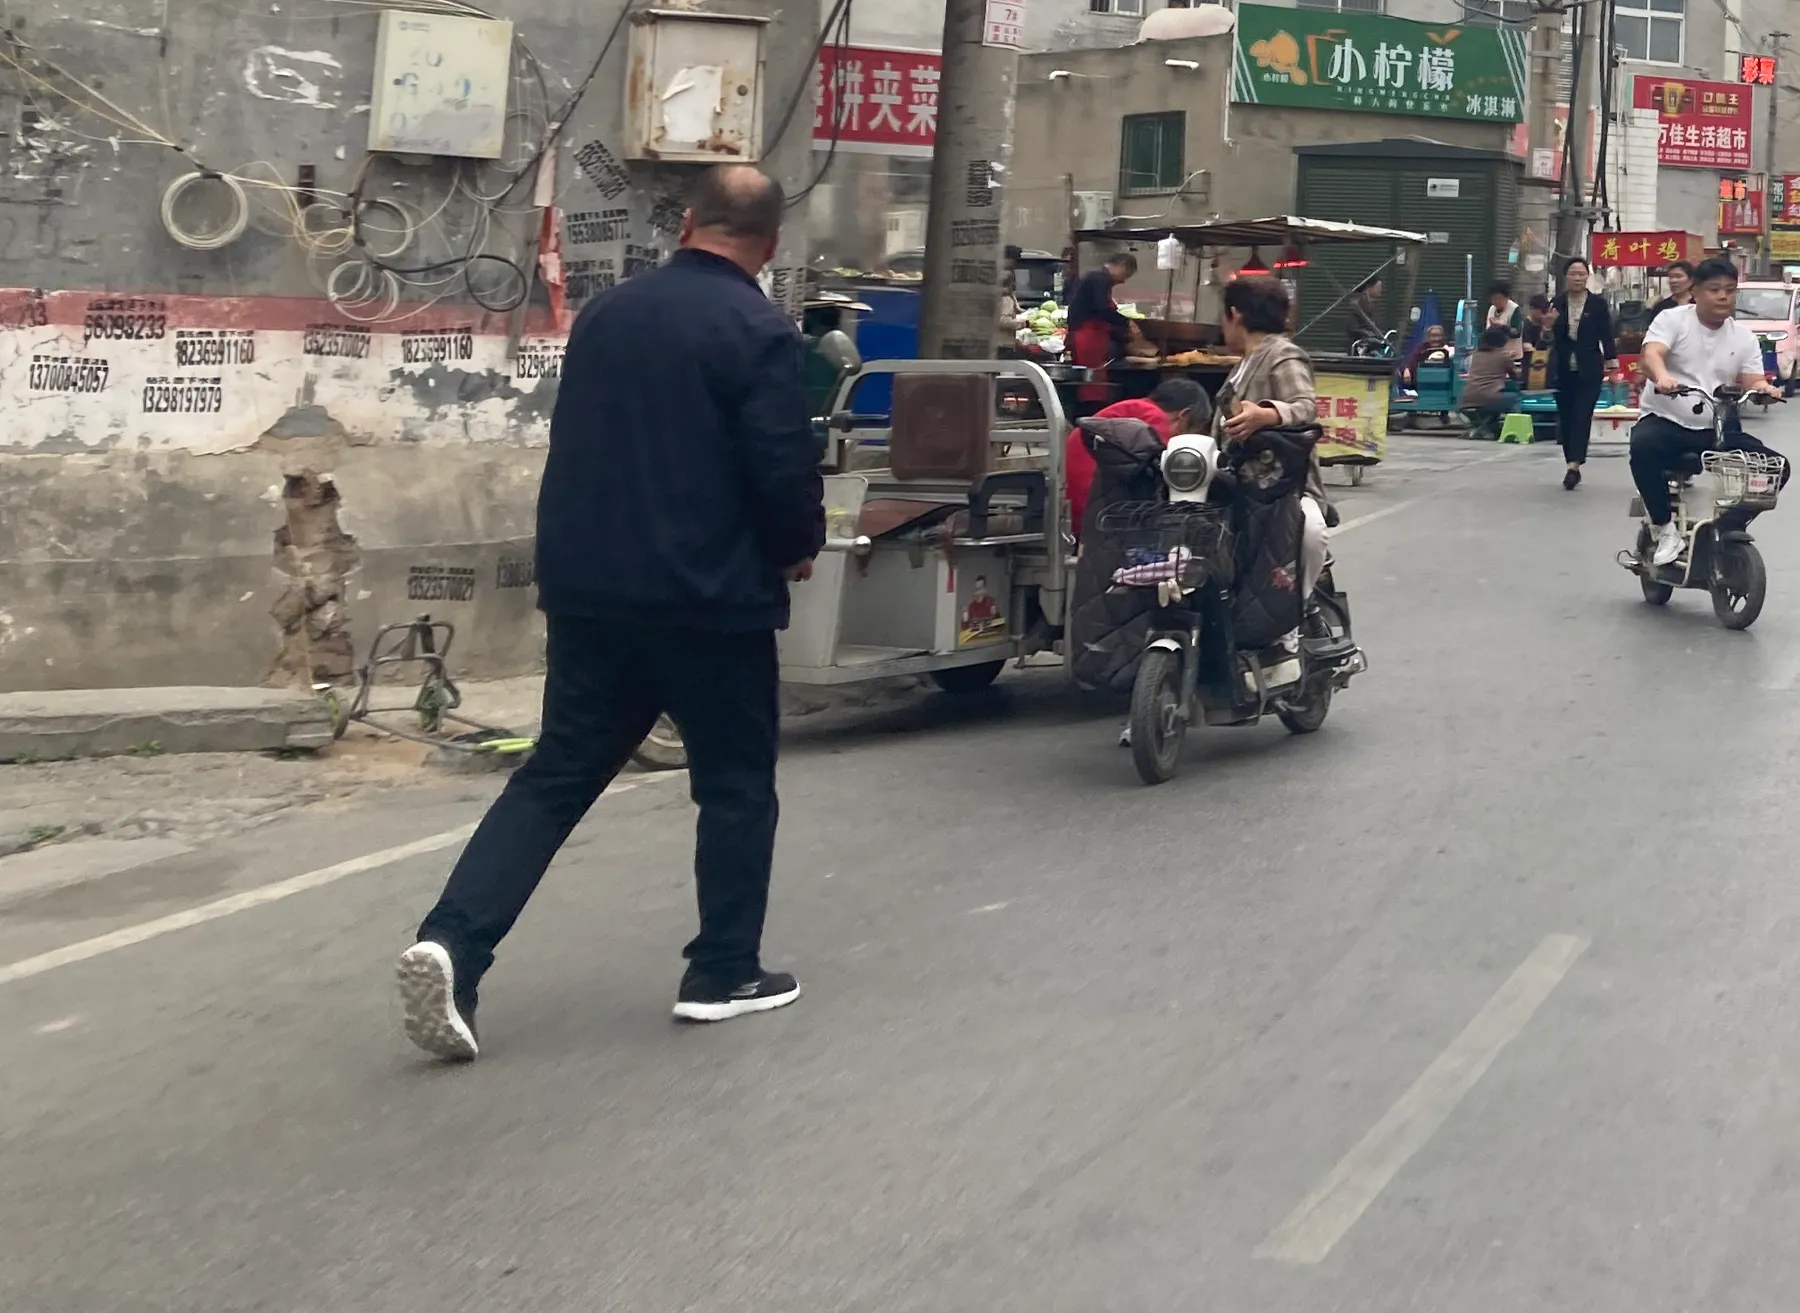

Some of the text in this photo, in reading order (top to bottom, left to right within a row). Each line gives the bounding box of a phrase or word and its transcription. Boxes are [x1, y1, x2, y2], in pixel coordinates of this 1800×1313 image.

[1328, 38, 1455, 92] 小柠檬
[1742, 56, 1776, 85] 彩票
[1465, 94, 1517, 119] 冰淇淋
[1600, 236, 1680, 262] 荷叶鸡
[143, 386, 222, 413] 13298197979
